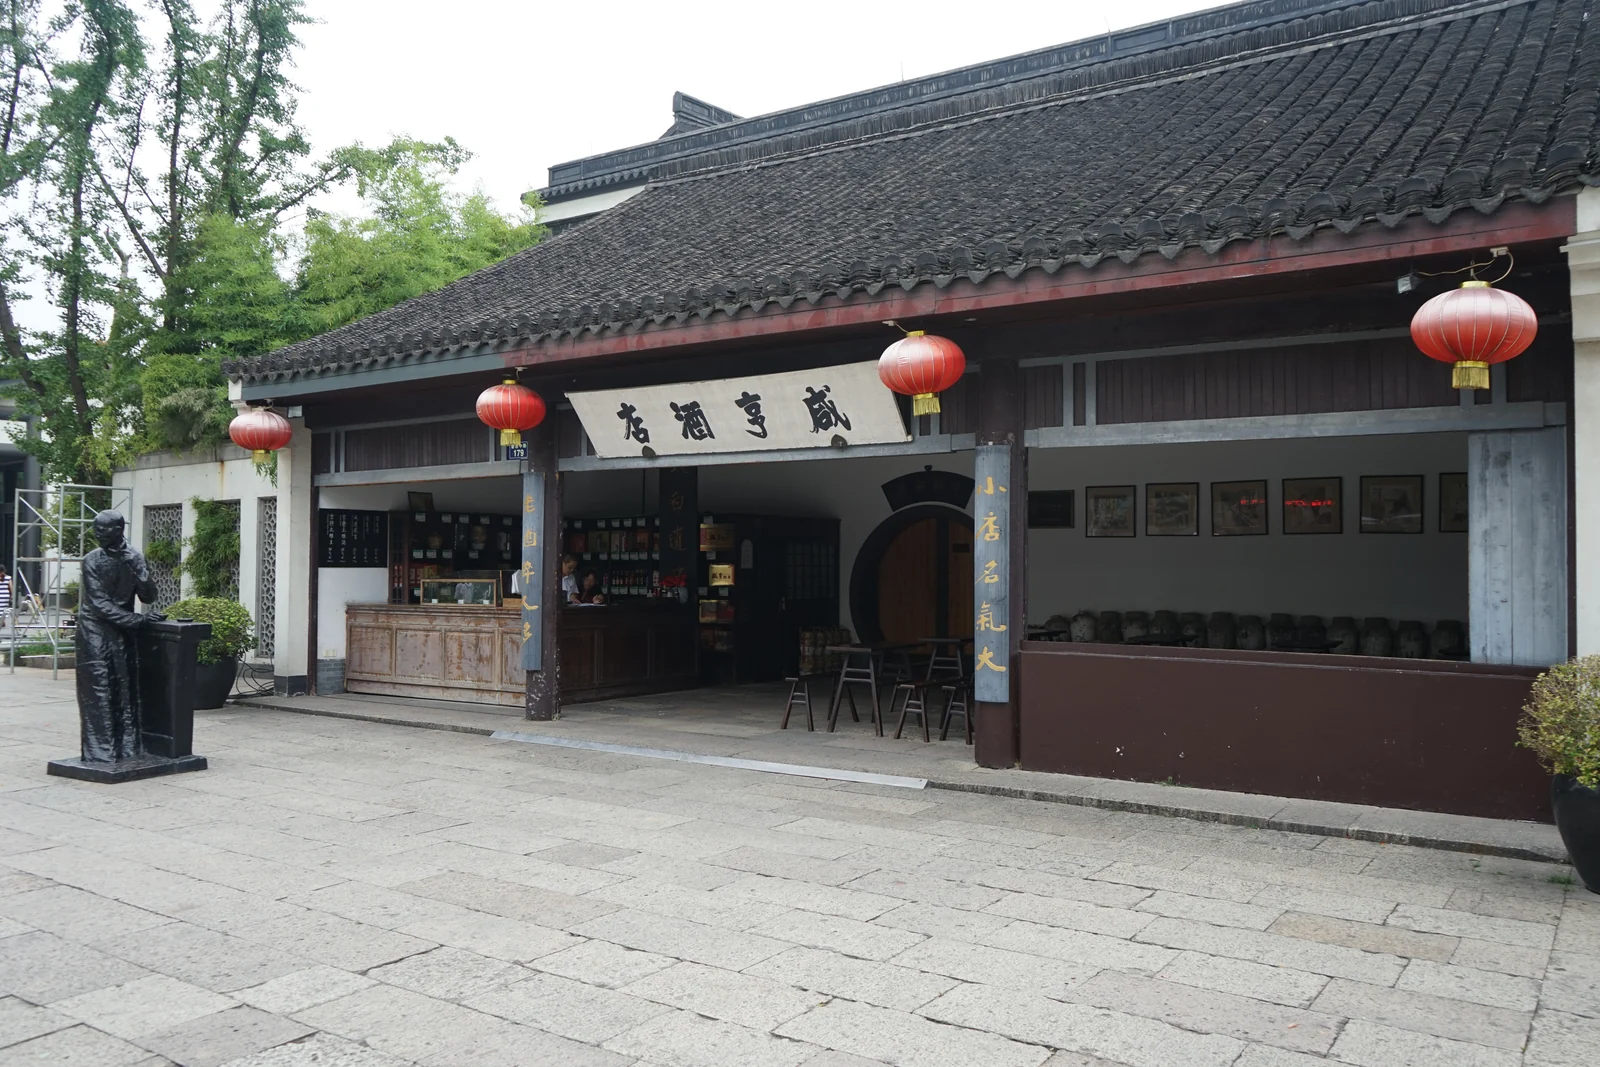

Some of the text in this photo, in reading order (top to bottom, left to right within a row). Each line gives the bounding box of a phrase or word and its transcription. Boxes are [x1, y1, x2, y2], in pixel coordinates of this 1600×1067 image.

[513, 449, 525, 457] 179
[975, 476, 1007, 672] 小店名氣大
